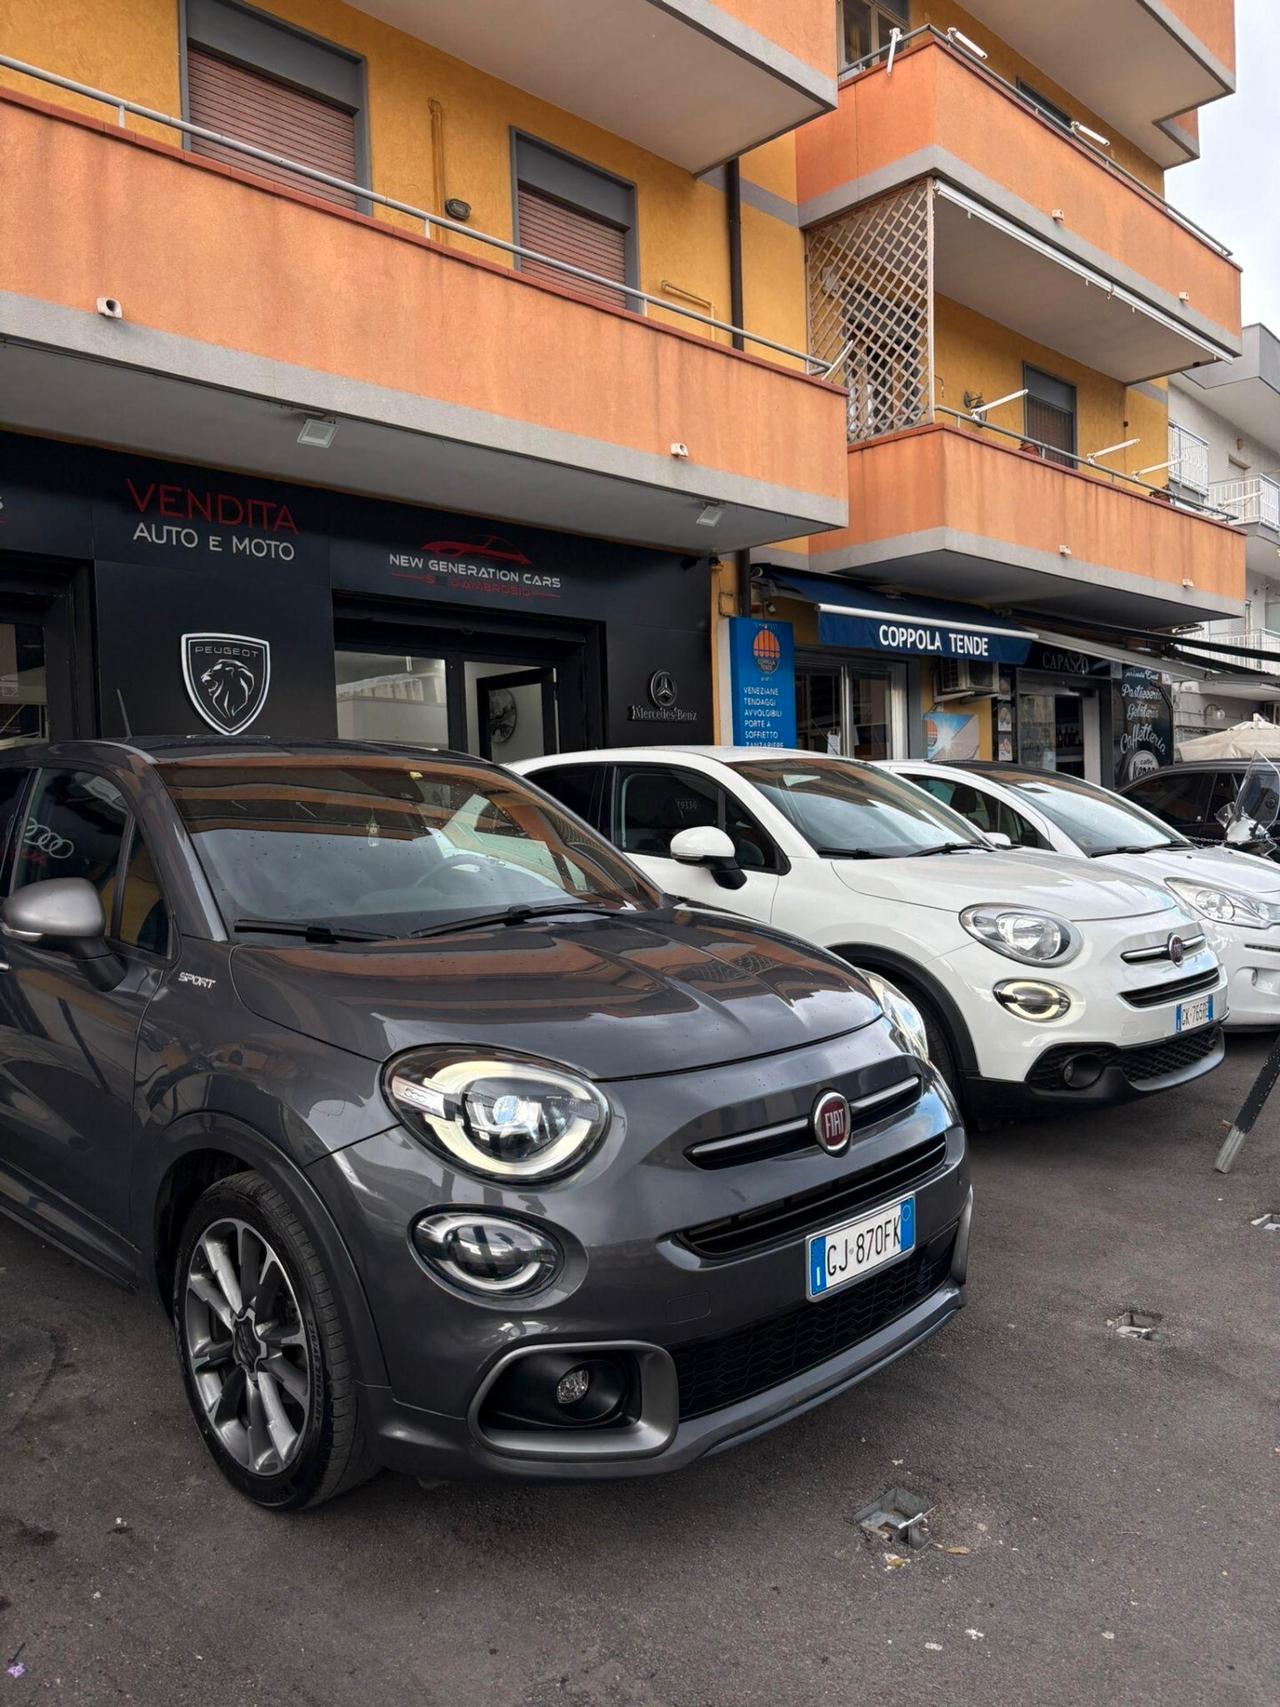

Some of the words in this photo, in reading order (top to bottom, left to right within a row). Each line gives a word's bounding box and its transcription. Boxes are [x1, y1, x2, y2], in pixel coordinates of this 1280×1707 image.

[127, 478, 299, 535] VENDITA
[133, 522, 198, 548] AUTO
[209, 536, 223, 551] E
[232, 536, 295, 561] MOTO
[389, 553, 424, 569] NEW
[428, 559, 520, 583] GENERATION
[522, 573, 562, 589] CARS
[879, 624, 943, 651] COPPOLA
[949, 633, 989, 656] TENDE
[194, 646, 259, 658] PEUGEOT
[744, 686, 779, 696] VENEZIANE
[744, 709, 782, 718] AVVOLGIBILI
[744, 719, 765, 728] PORTE
[744, 730, 779, 739] SOFFIETTO
[178, 971, 216, 989] SPORT
[824, 1108, 845, 1138] FIAT
